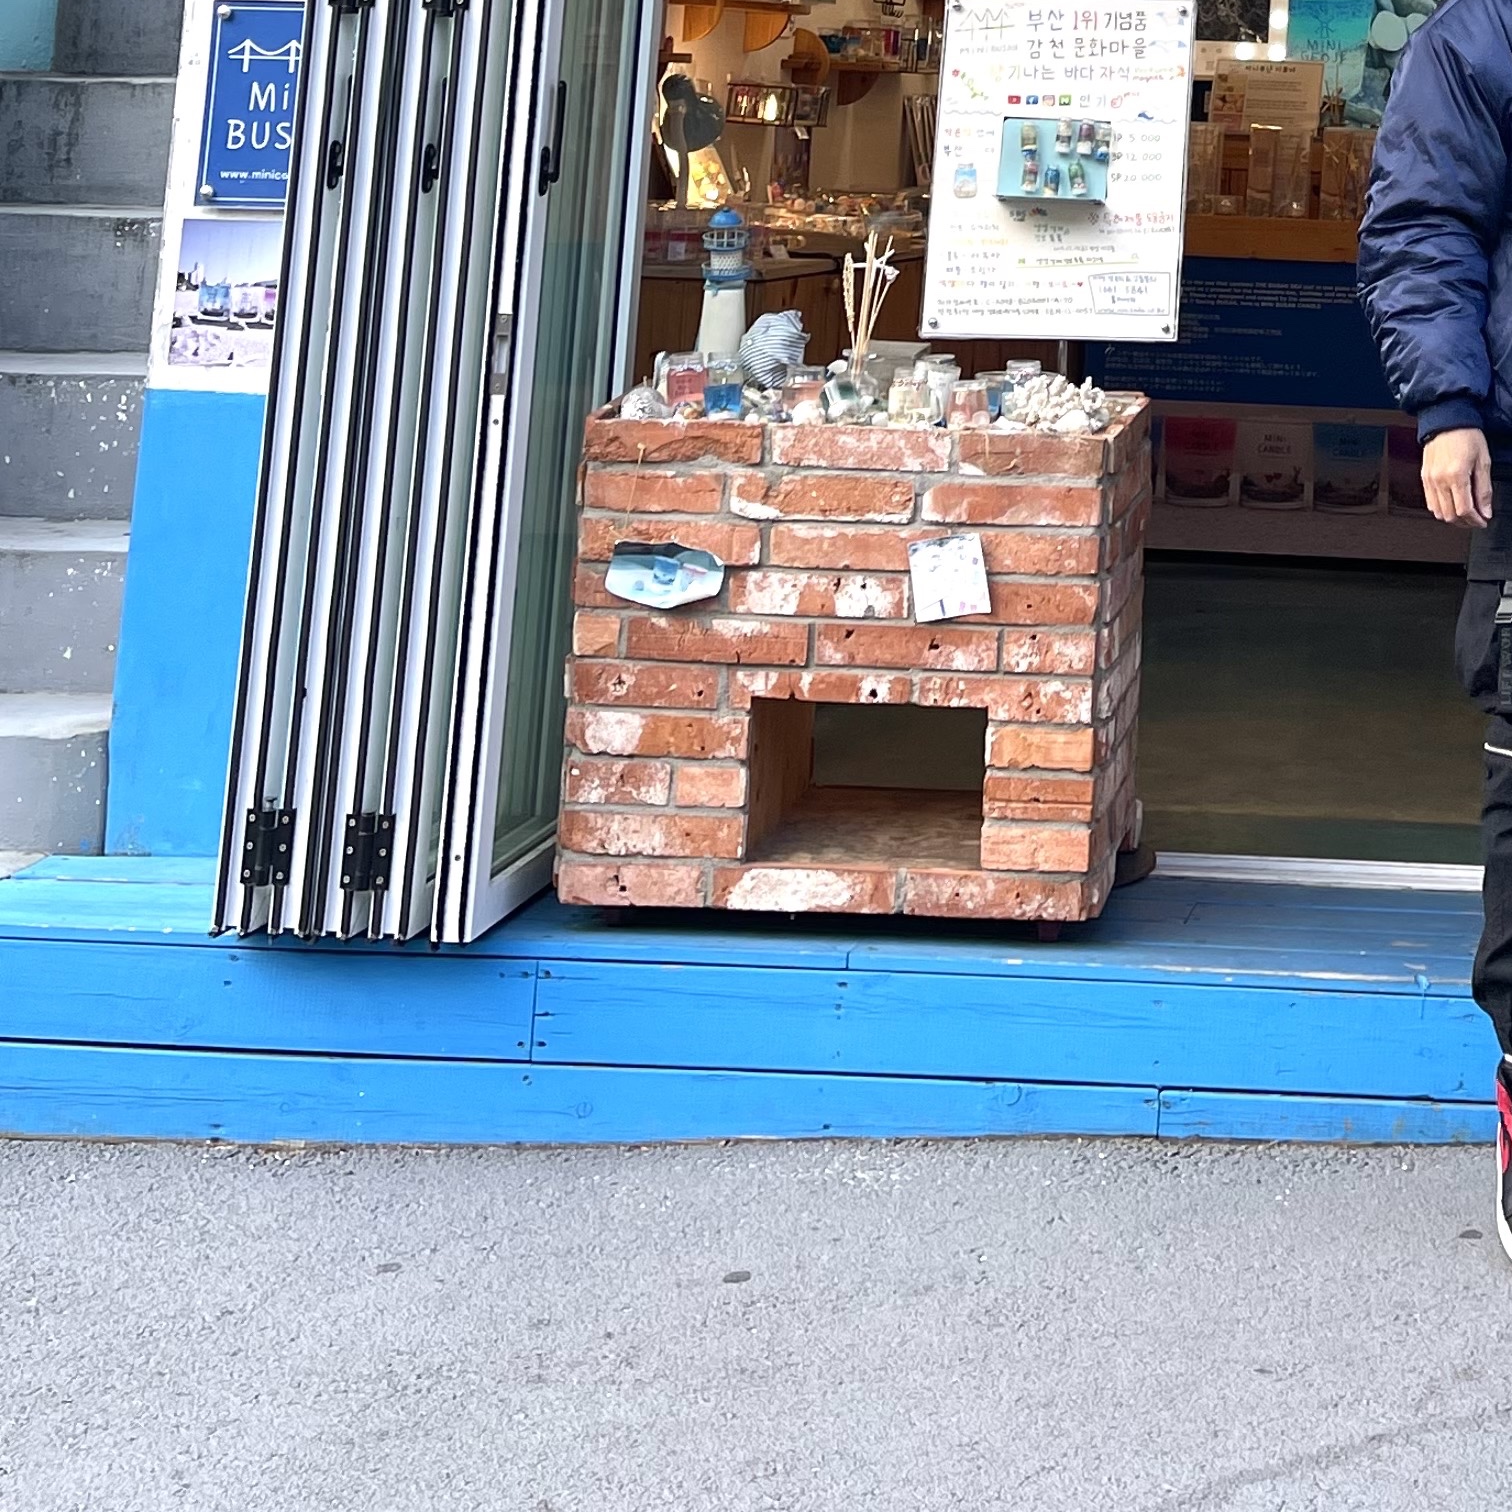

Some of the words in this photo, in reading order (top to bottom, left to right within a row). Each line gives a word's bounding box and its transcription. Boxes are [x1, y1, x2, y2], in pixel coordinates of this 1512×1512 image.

[1026, 8, 1066, 33] 부산
[1072, 9, 1099, 32] 1위
[1103, 10, 1148, 33] 기념품
[1064, 64, 1095, 81] 바다
[1100, 65, 1131, 82] 자석
[248, 81, 290, 113] Mi
[226, 118, 291, 150] BUS
